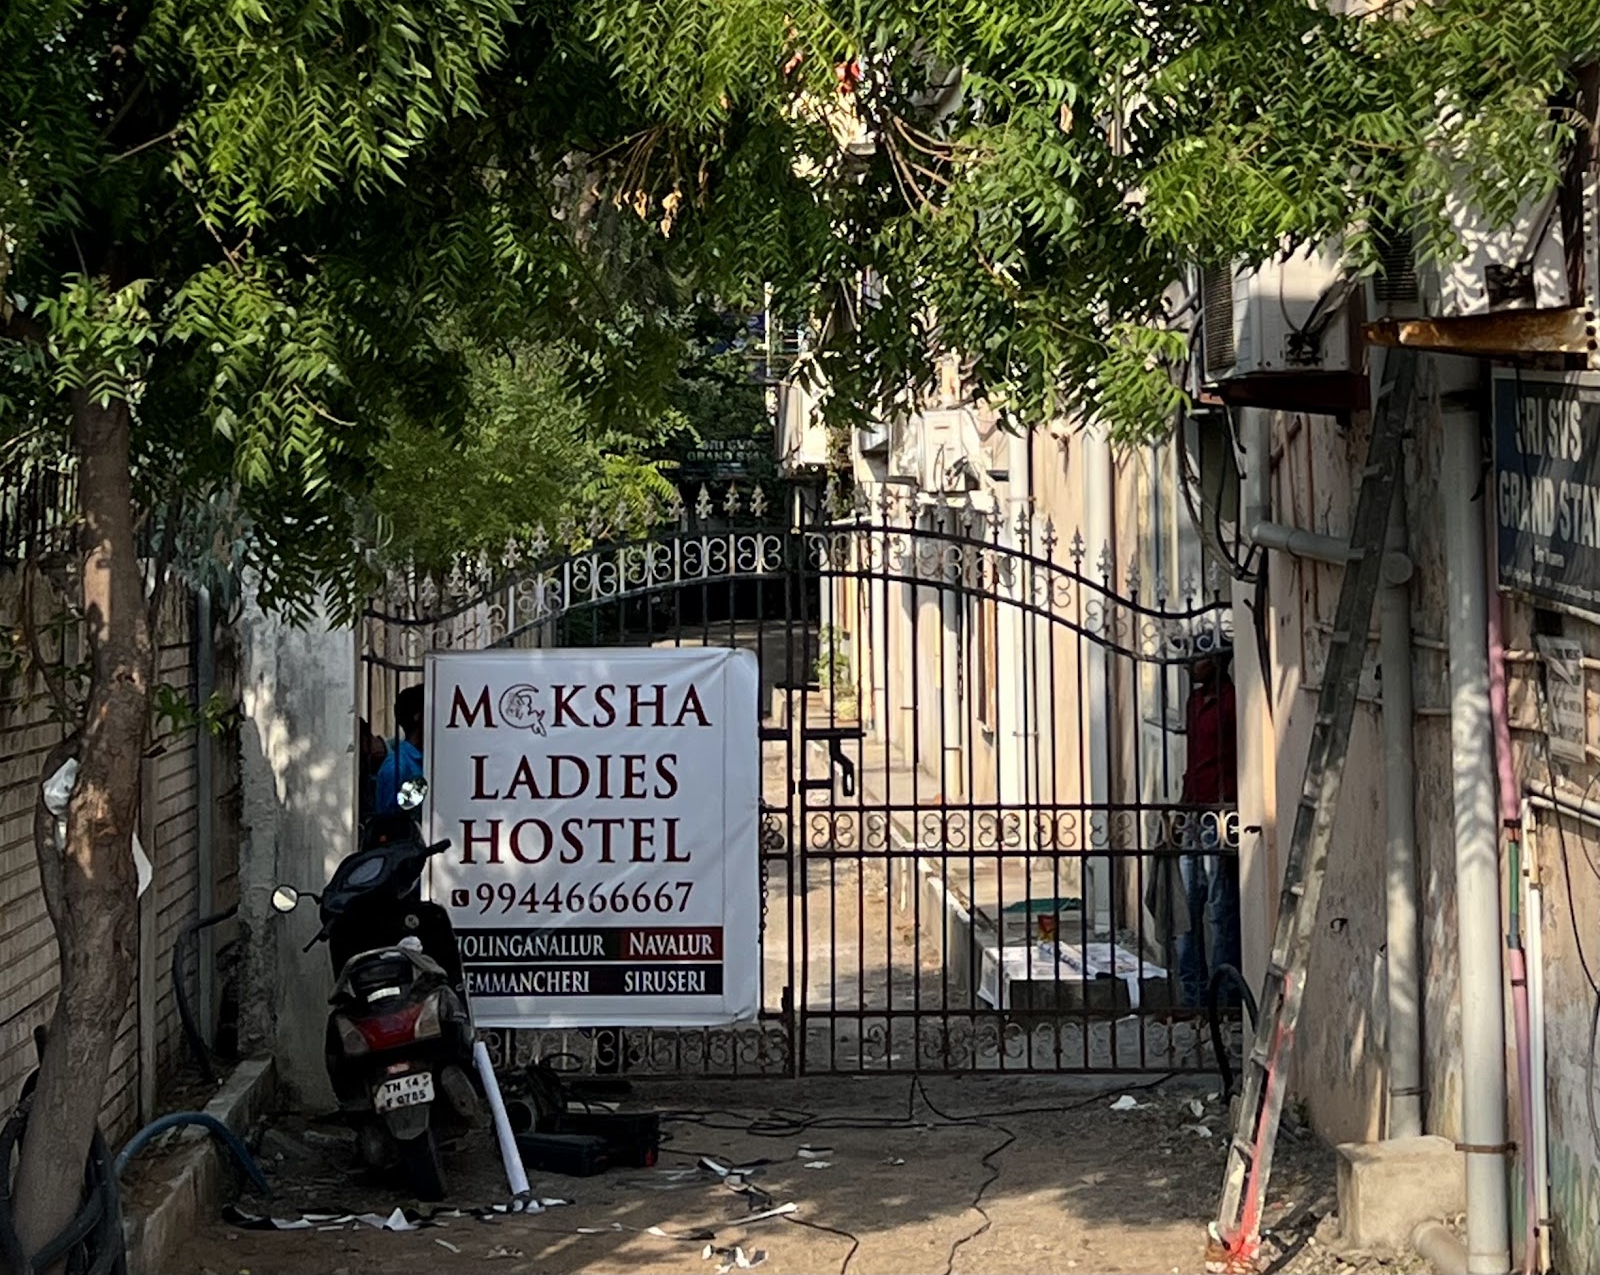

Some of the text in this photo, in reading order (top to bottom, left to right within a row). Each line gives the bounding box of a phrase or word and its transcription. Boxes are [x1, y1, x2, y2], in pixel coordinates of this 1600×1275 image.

[445, 683, 713, 737] MOKSHA
[471, 754, 679, 800] LADIES
[458, 817, 692, 865] HOSTEL
[476, 881, 694, 915] 9944666667
[464, 970, 707, 993] EMMANCHERI SIRUSERI
